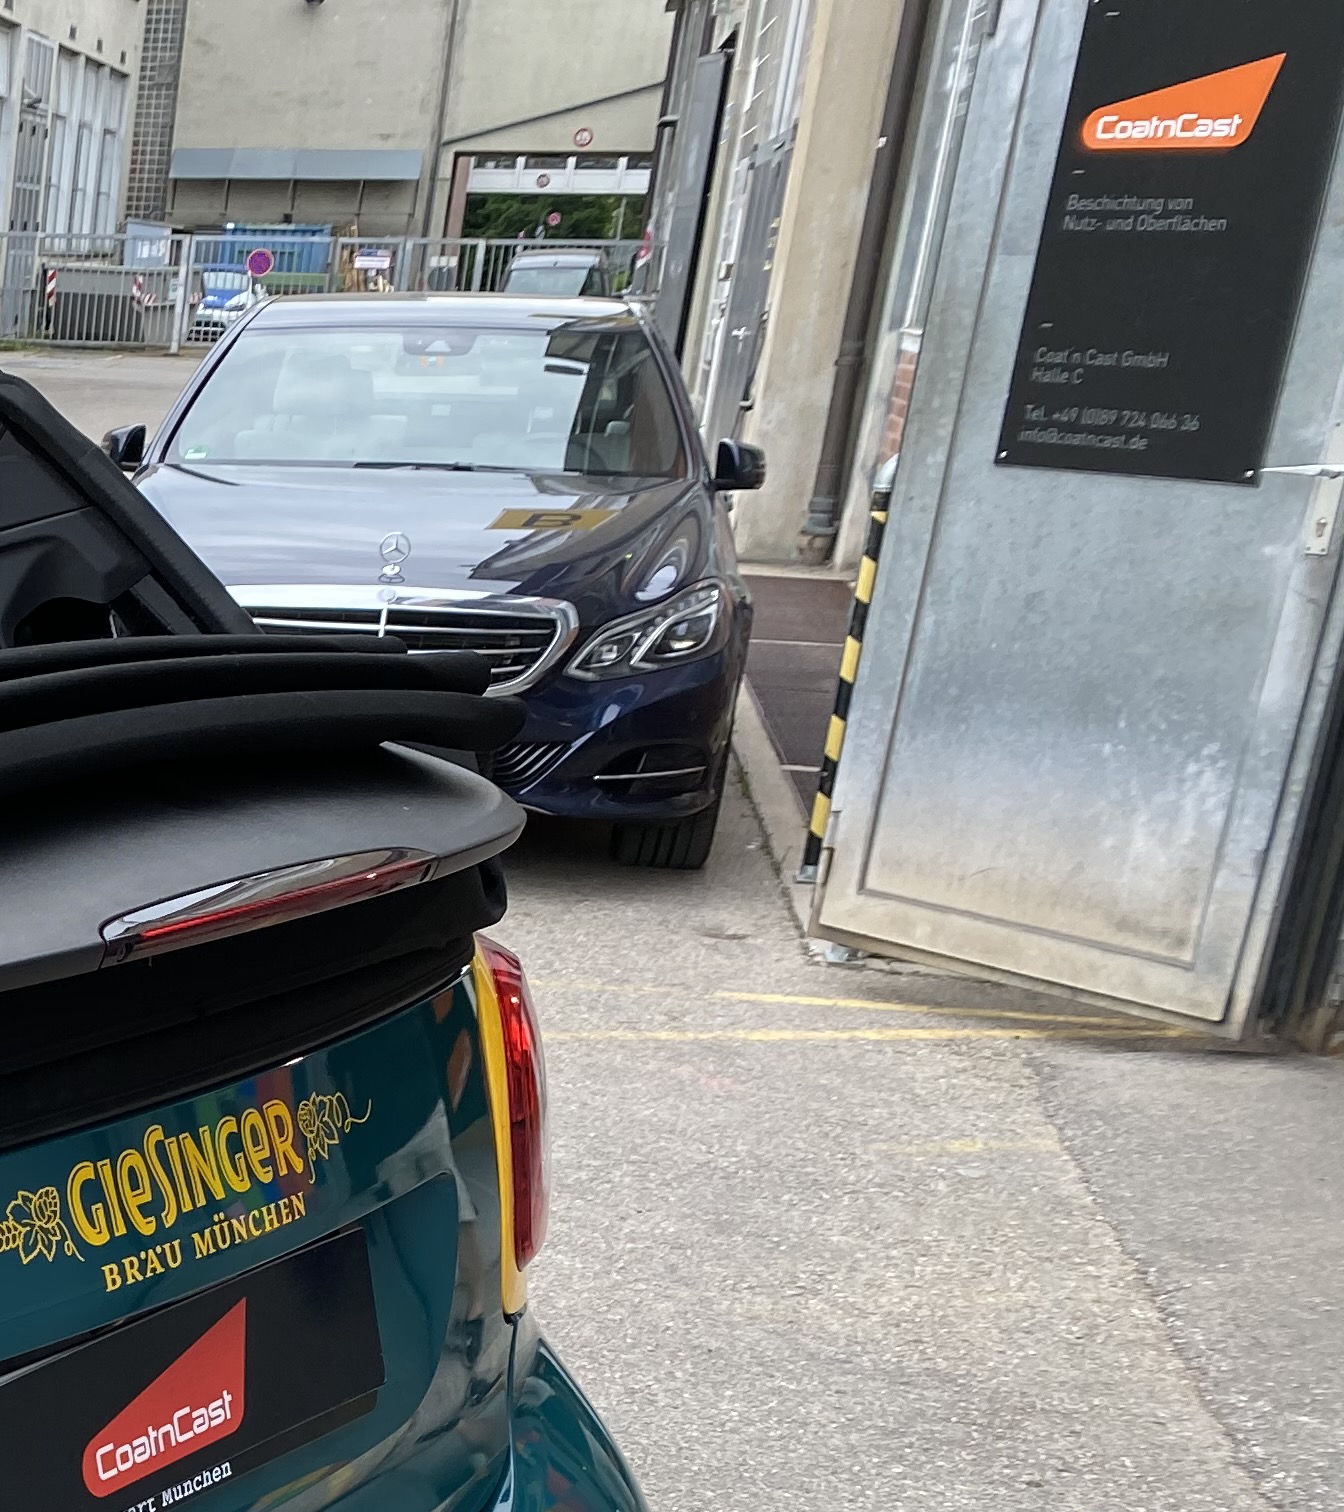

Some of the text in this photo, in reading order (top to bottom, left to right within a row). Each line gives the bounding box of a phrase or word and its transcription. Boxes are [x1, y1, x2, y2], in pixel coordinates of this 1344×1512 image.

[1095, 113, 1243, 140] CoatnCast
[1066, 193, 1194, 215] Beschichtung von
[1062, 214, 1228, 232] Nutz- und Oberflächen
[1085, 348, 1119, 366] Cast
[1121, 350, 1170, 368] GmbH
[1031, 366, 1084, 384] Halle C
[1052, 406, 1080, 423] +49
[101, 1190, 308, 1293] BRÄU MÜNCHEN
[95, 1389, 234, 1482] CoatnCast
[161, 1461, 233, 1507] Munchen
